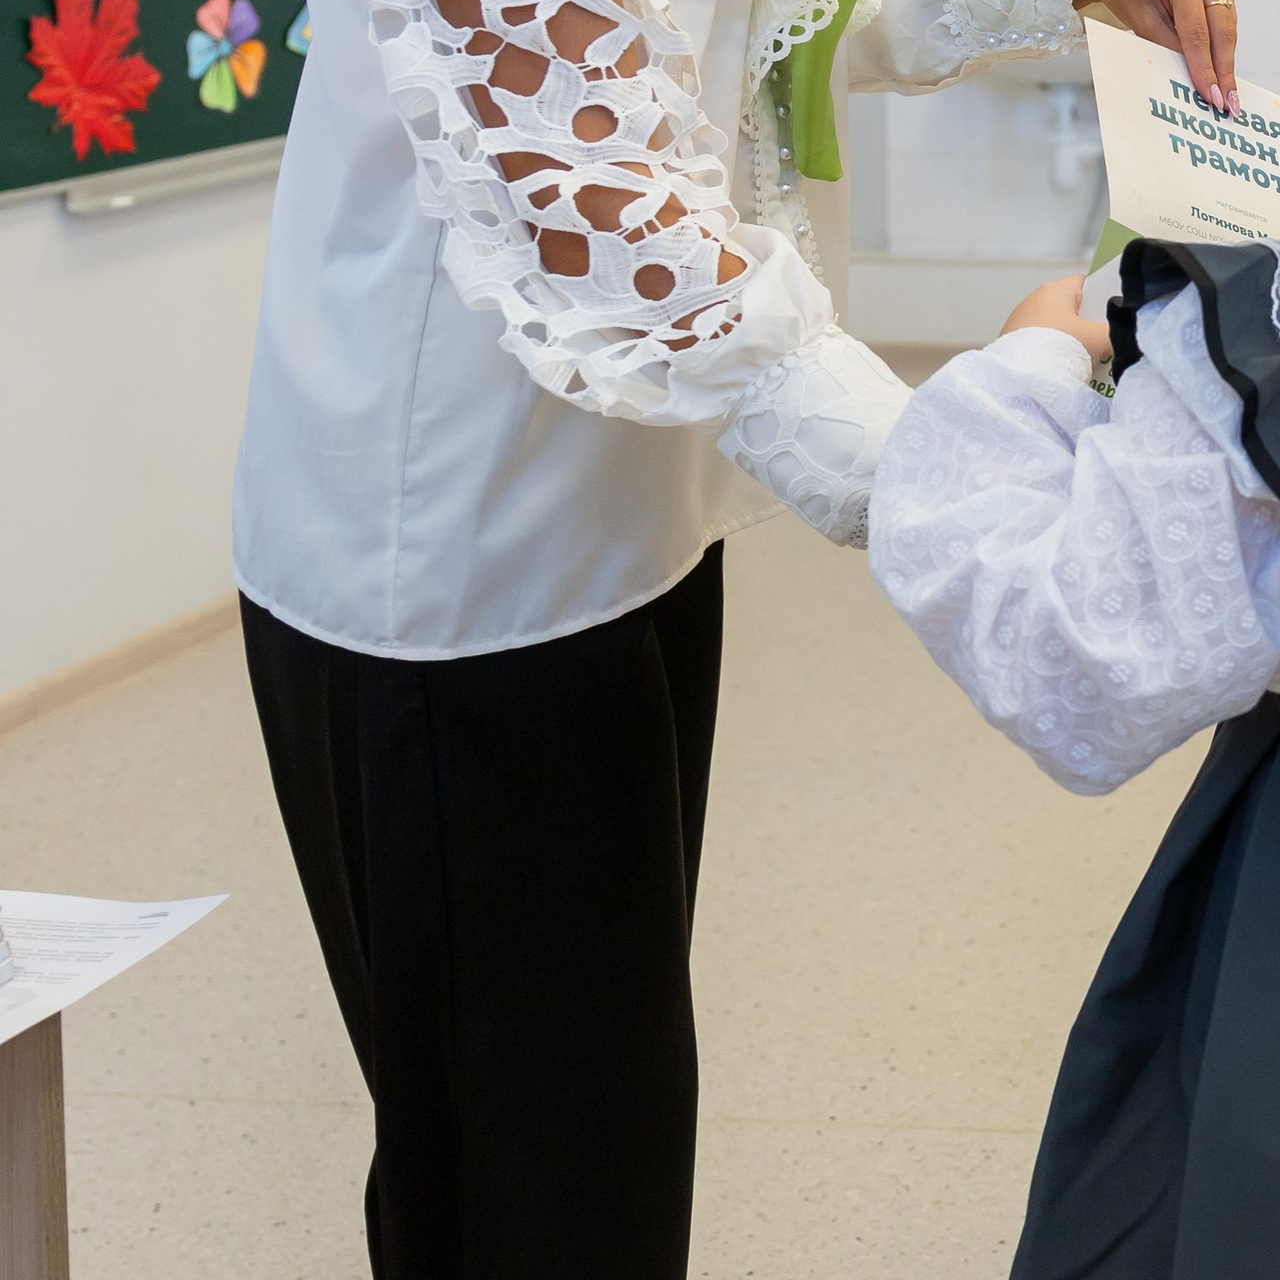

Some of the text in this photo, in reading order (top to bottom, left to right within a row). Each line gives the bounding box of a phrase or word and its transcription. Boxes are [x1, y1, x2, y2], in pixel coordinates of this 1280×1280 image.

[1159, 215, 1185, 231] МБОУ
[1186, 225, 1207, 239] СОШ
[1190, 206, 1255, 239] Логинова
